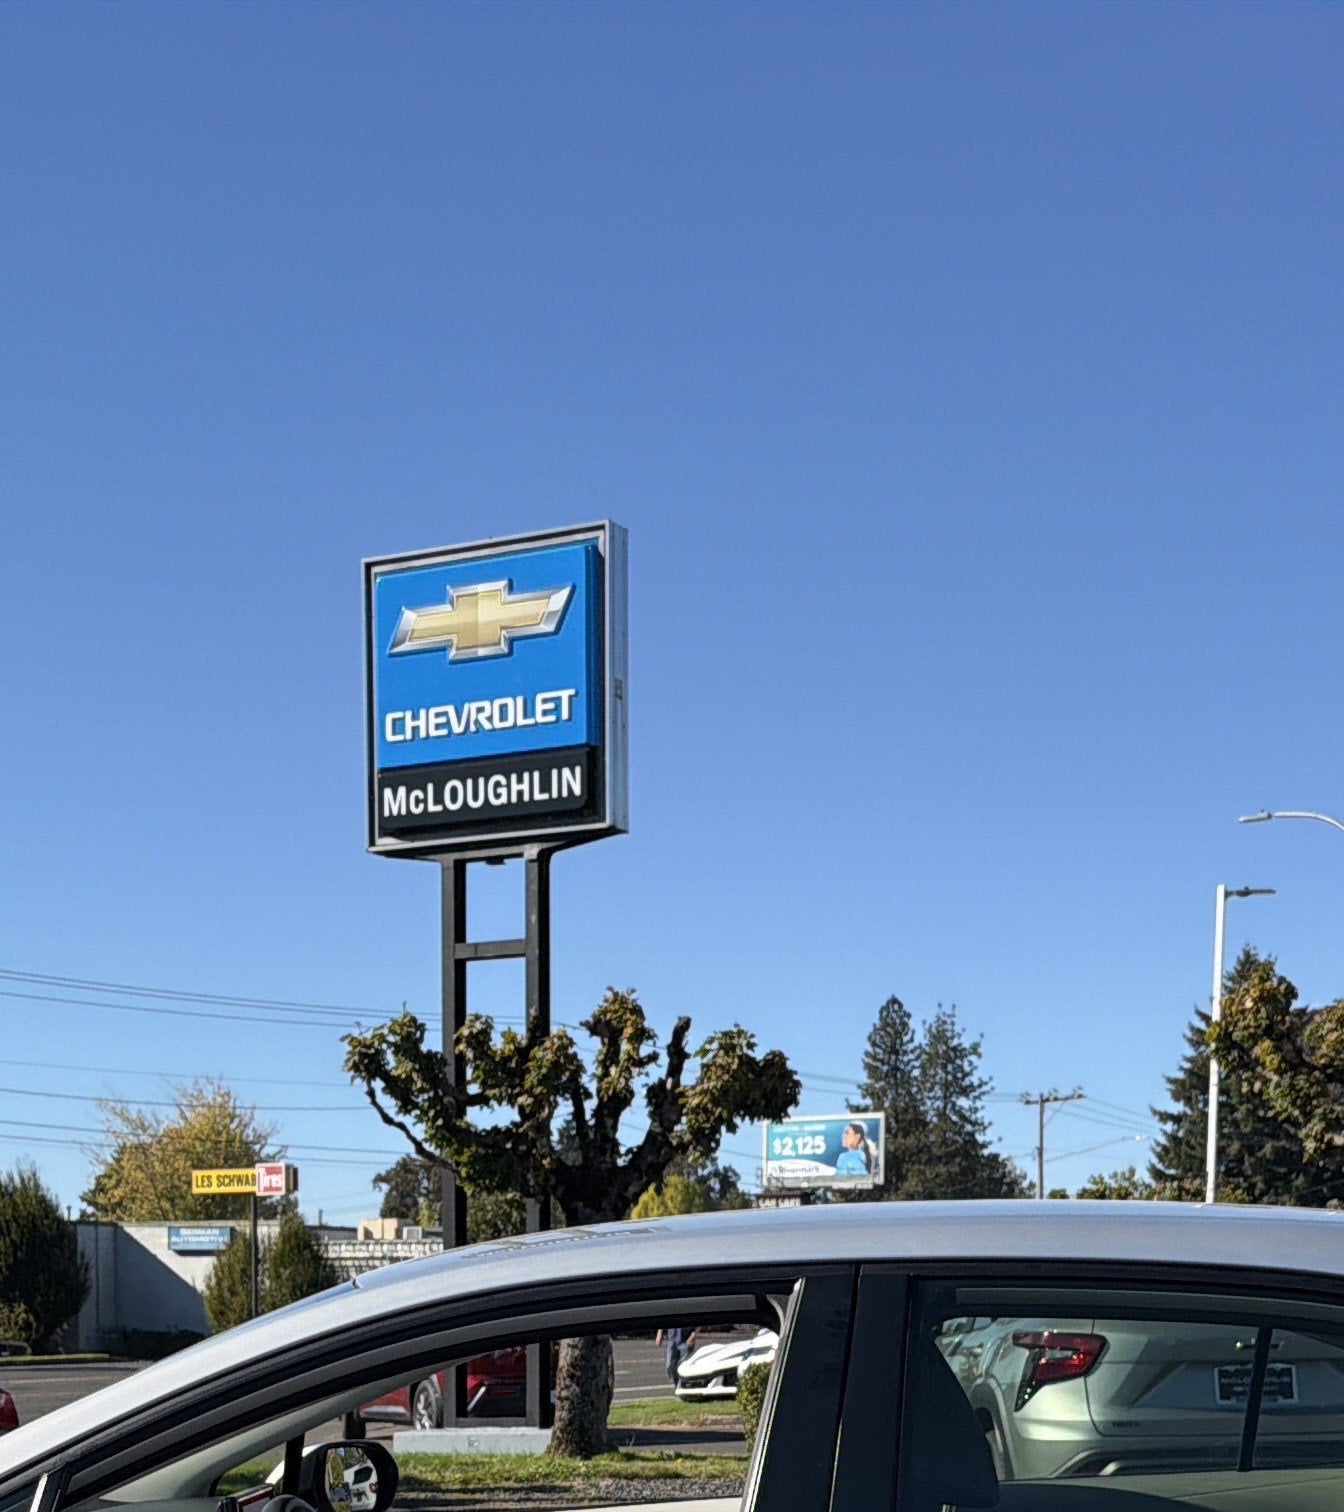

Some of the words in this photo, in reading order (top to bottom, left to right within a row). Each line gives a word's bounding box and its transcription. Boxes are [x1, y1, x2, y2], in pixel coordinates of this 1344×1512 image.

[385, 688, 576, 743] CHEVROLET
[383, 764, 582, 818] McLOUGHLIN
[773, 1135, 826, 1157] $2,125
[195, 1175, 213, 1189] LES
[216, 1173, 256, 1188] SCHWAB
